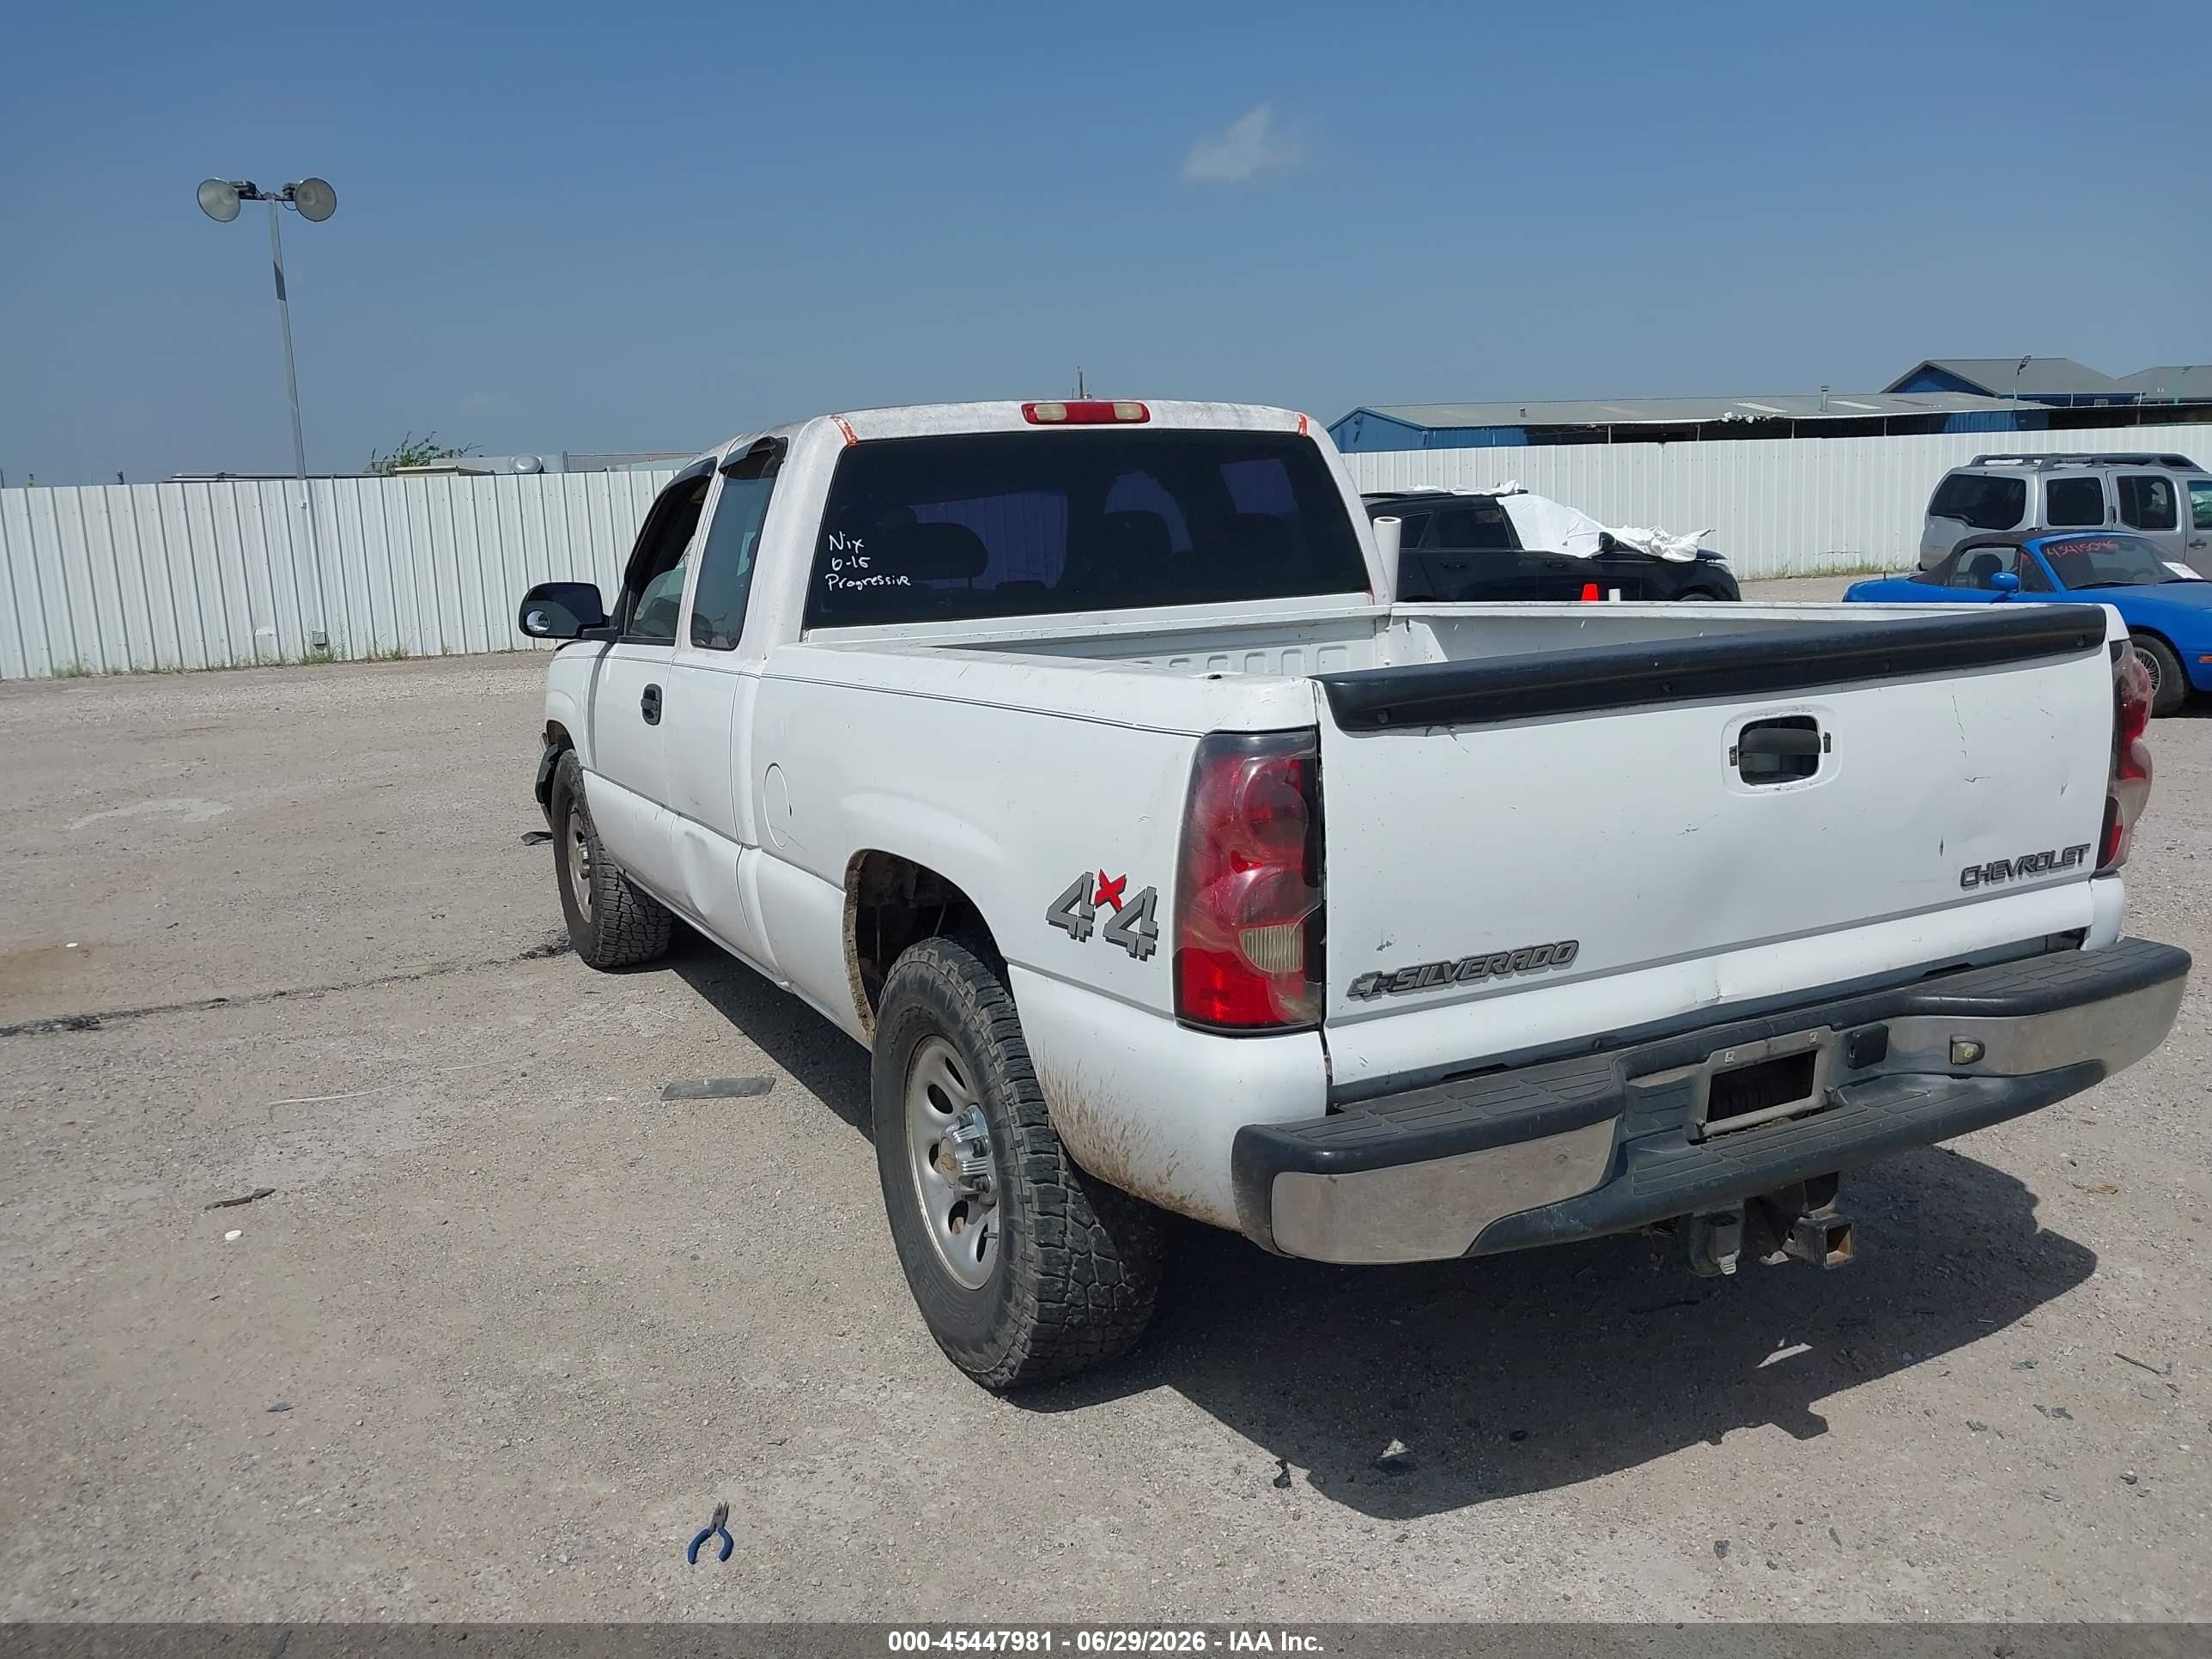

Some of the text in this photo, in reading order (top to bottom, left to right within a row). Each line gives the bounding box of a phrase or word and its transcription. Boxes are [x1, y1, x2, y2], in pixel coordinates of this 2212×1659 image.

[829, 531, 865, 554] Nix
[824, 574, 912, 591] Progressive
[1960, 843, 2091, 888] CHEVROLET
[1390, 939, 1579, 993] SILVERADO
